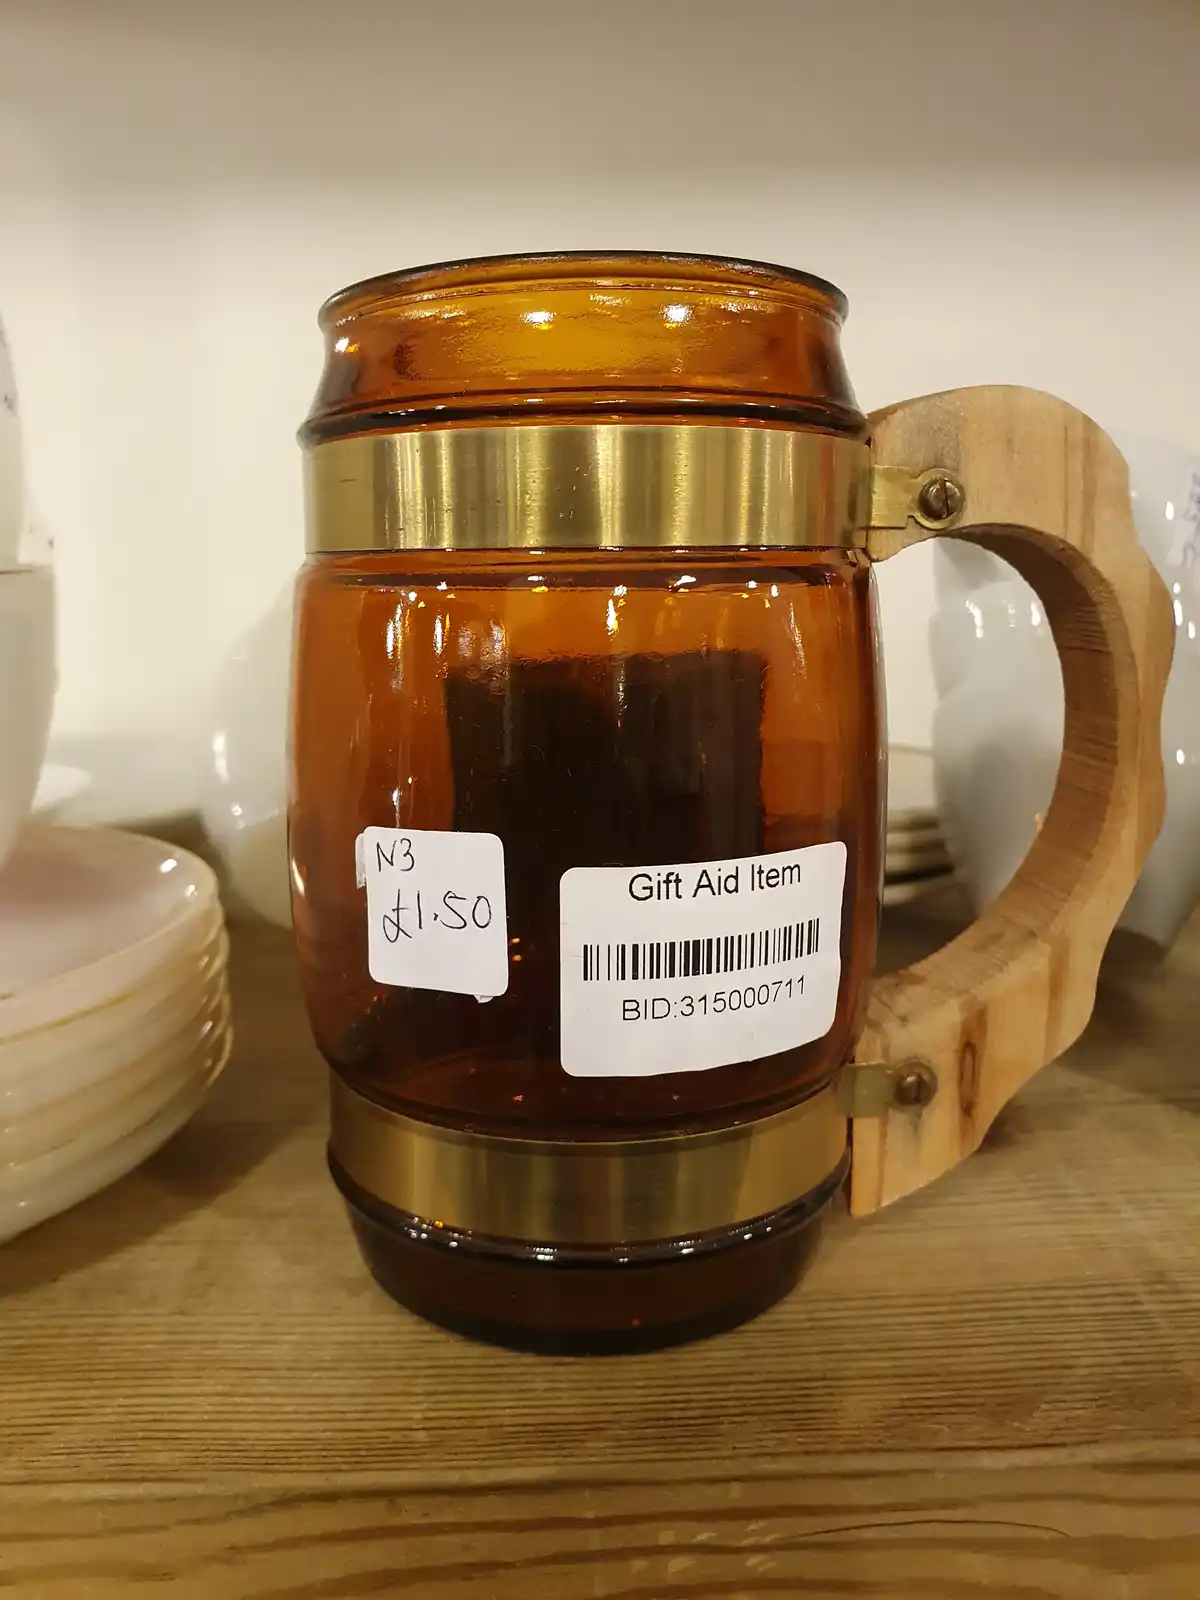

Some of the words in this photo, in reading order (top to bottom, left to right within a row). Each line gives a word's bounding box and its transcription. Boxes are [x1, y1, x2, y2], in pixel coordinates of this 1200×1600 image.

[376, 838, 415, 872] N3
[628, 871, 683, 901] Gift
[692, 865, 740, 898] Aid
[751, 863, 801, 891] Item
[383, 888, 492, 943] £1.50
[622, 975, 805, 1021] BID:315000711
